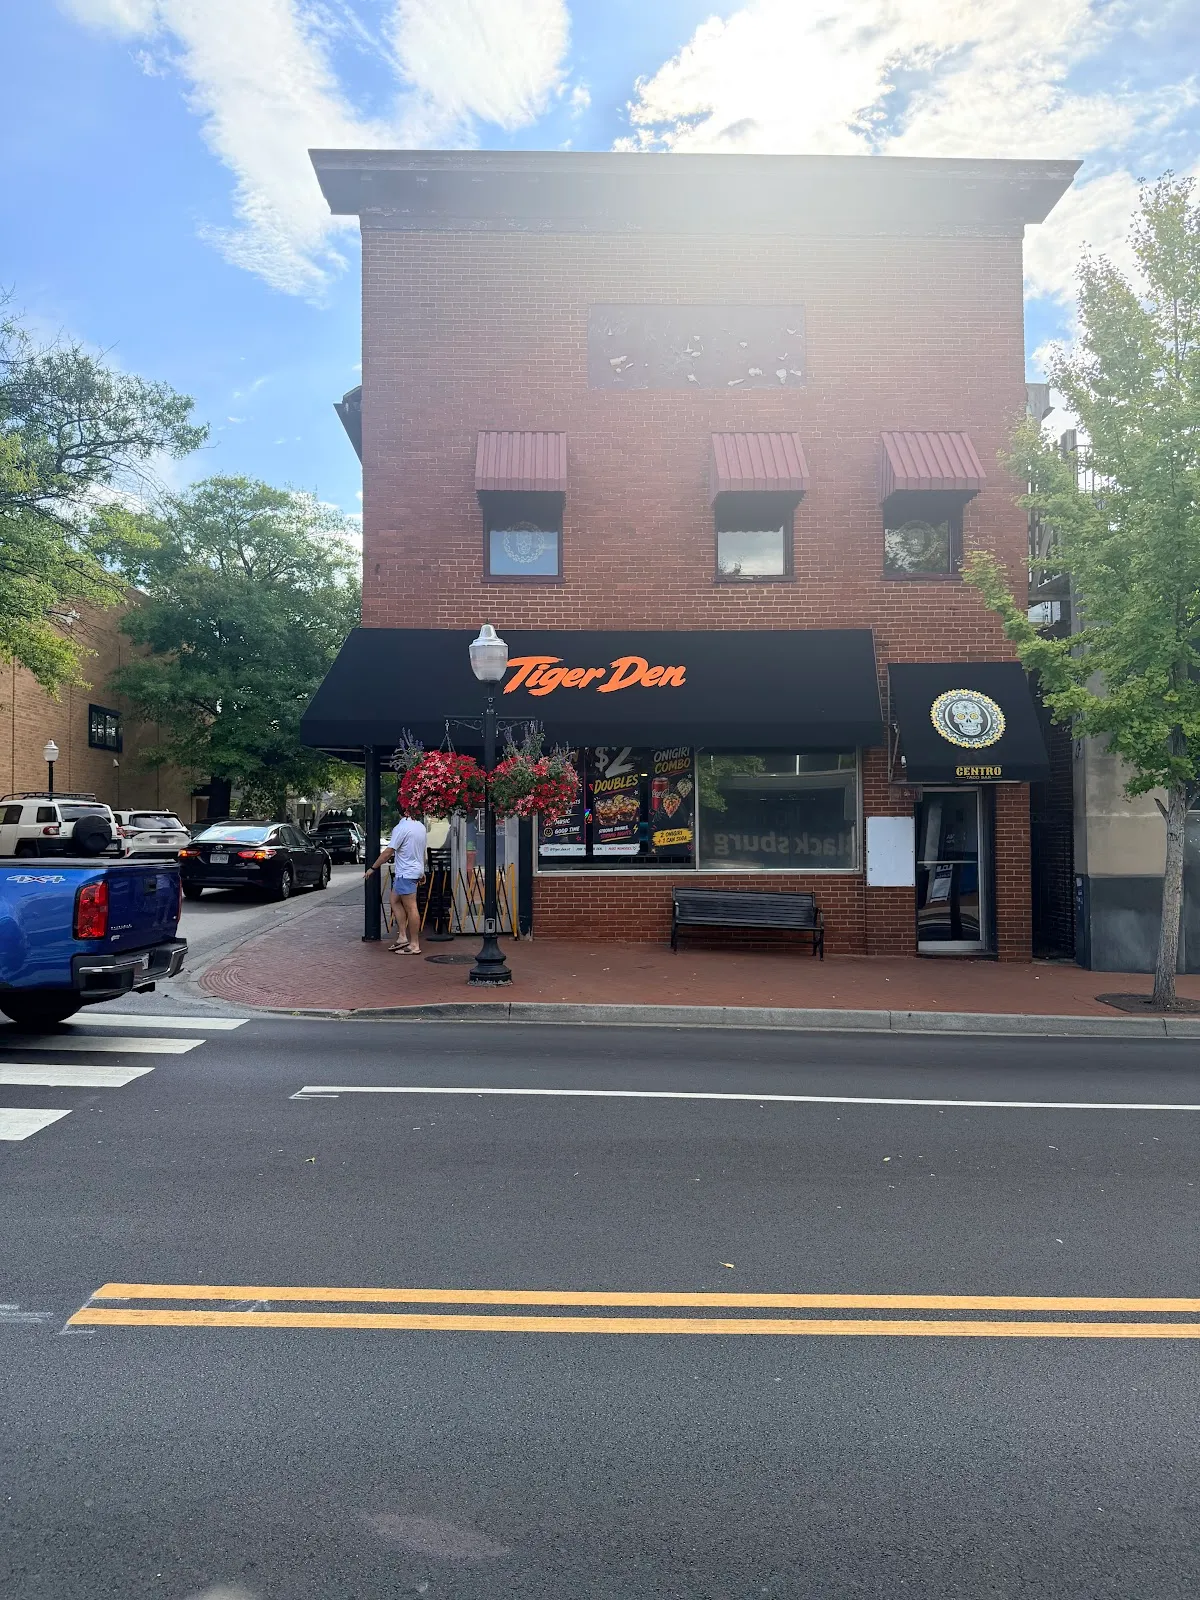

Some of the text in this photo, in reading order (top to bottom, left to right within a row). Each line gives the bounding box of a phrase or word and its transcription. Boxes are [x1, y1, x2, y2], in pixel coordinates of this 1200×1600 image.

[503, 656, 686, 696] Tiger Den
[653, 747, 690, 762] ONIGIRI
[654, 758, 691, 774] COMBO
[956, 766, 1002, 776] CENTRO
[594, 774, 639, 794] DOUBLES
[554, 827, 569, 835] GOOD
